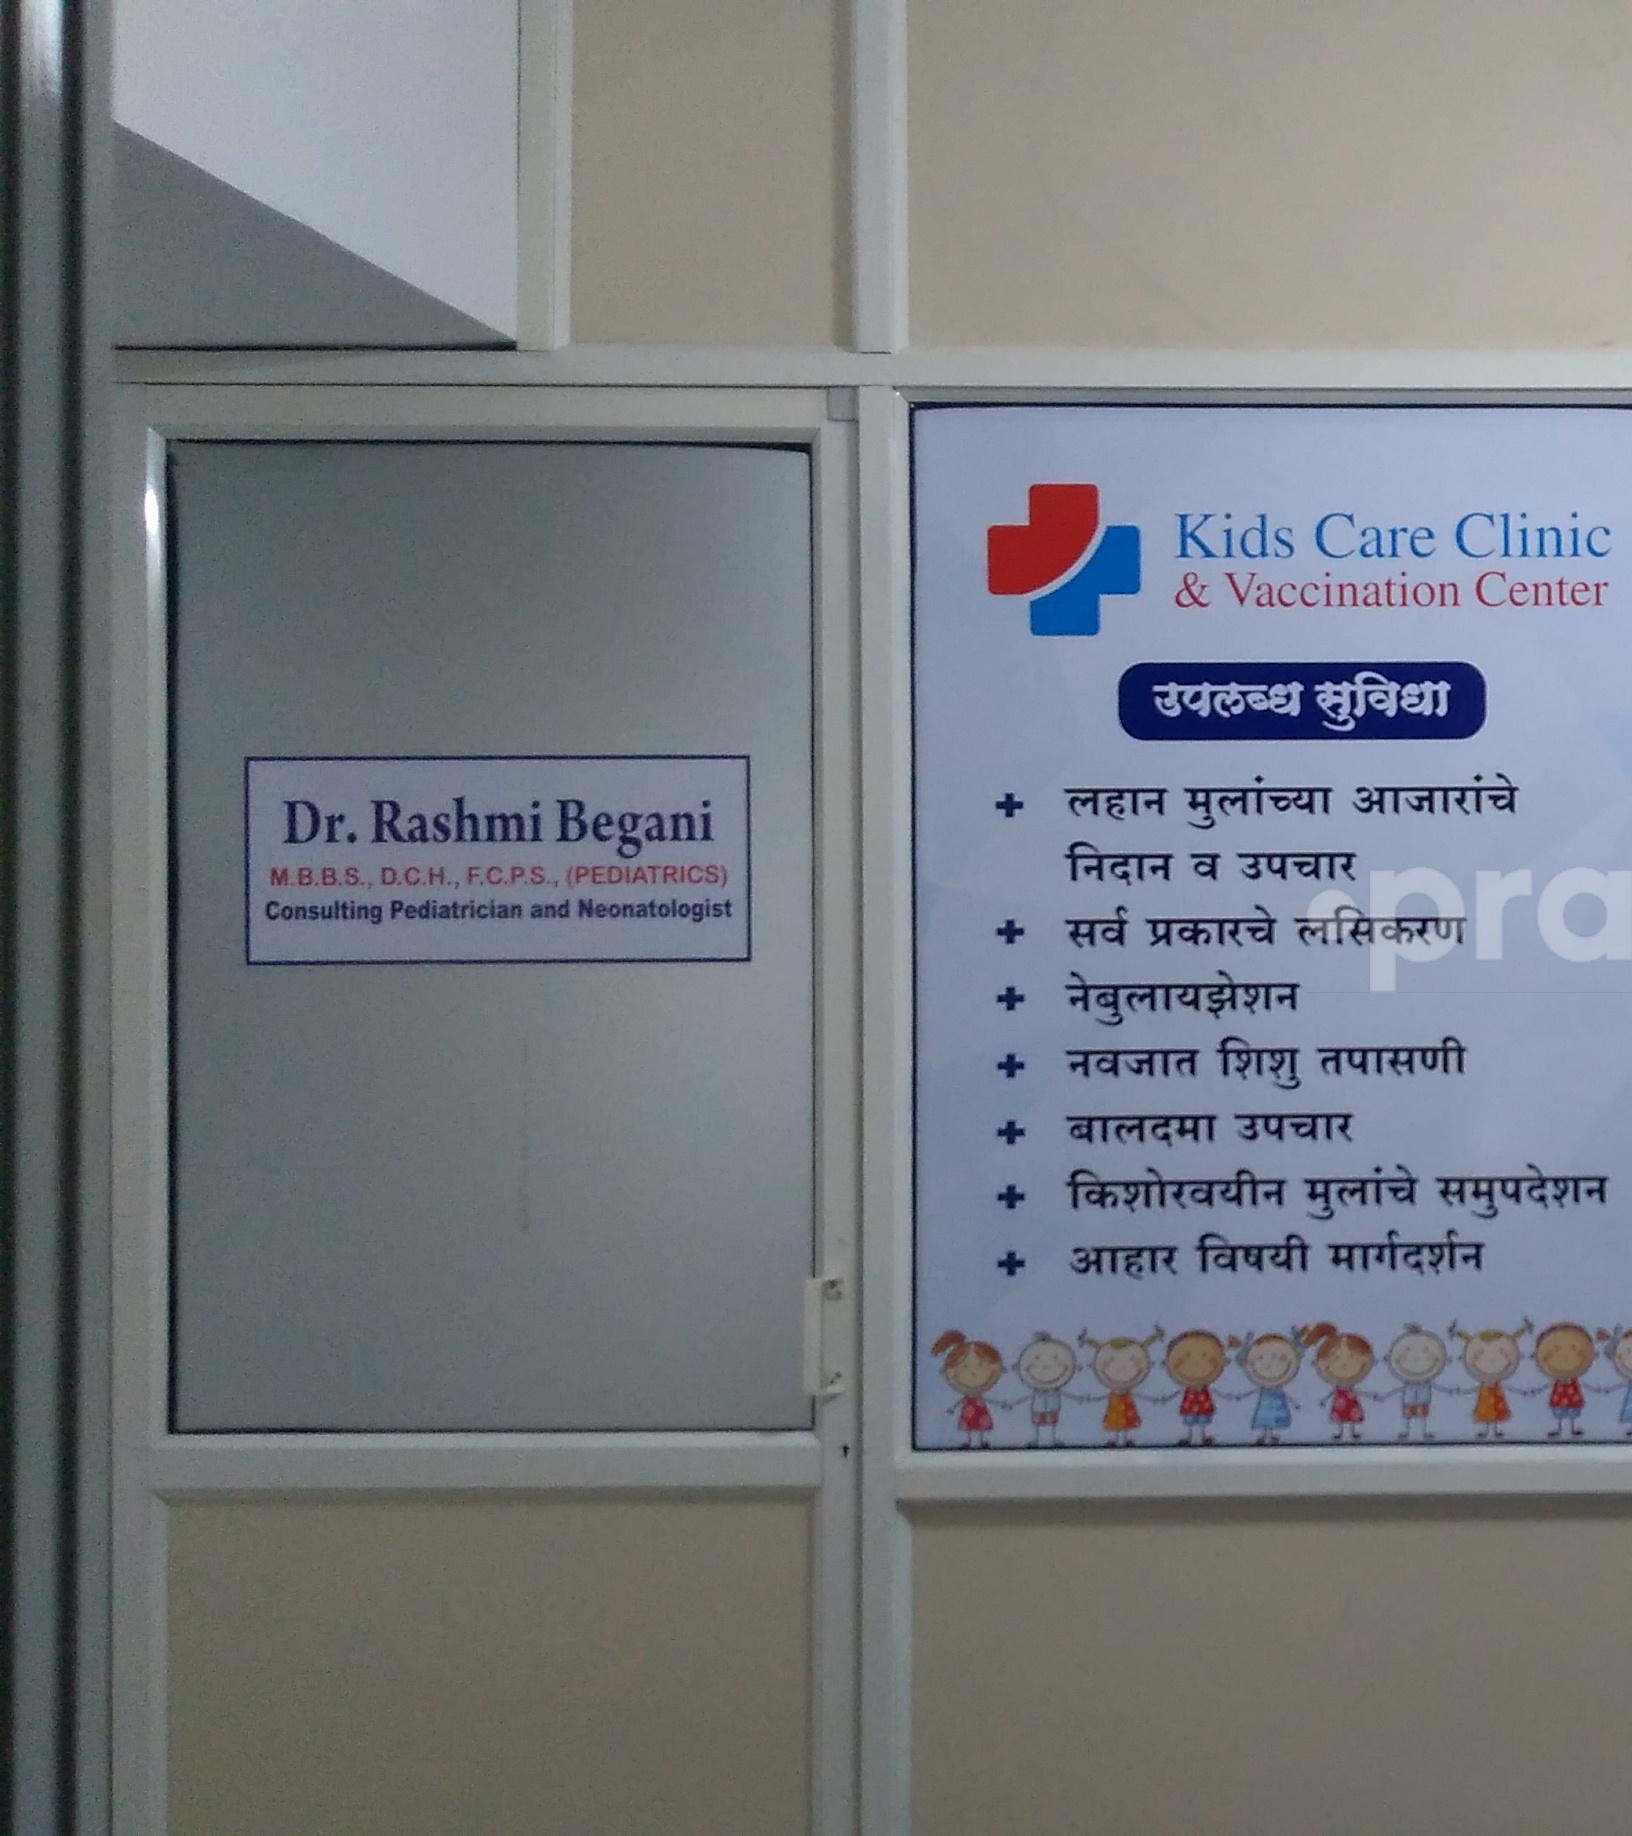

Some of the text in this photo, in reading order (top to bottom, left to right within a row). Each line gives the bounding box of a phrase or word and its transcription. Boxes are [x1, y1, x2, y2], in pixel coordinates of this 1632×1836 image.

[1176, 512, 1612, 560] Kids Care Clinic
[1175, 572, 1610, 609] & Vaccination Center
[1153, 671, 1453, 733] उपलब्ध सुविधा
[1064, 773, 1521, 832] लहान मुलांच्या आजारांचे
[284, 797, 716, 861] Dr. Rashmi Begani
[270, 865, 729, 891] M.B.B.S., D.C.H., F.C.P.S., (PEDIATRICS)
[1065, 841, 1359, 888] निदान व उपचार
[265, 899, 734, 926] Consulting Pediatrician and Neonatologist
[1065, 905, 1469, 950] सर्व प्रकारचे लसिकरण
[1065, 970, 1302, 1028] नेबुलायझेशन
[1066, 1036, 1468, 1091] नवजात शिशु तपासणी
[1066, 1113, 1355, 1149] बालदमा उपचार
[1066, 1164, 1610, 1222] किशोरवयीन मुलांचे समुपदेशन
[1070, 1229, 1487, 1280] आहार विषयी मार्गदर्शन
